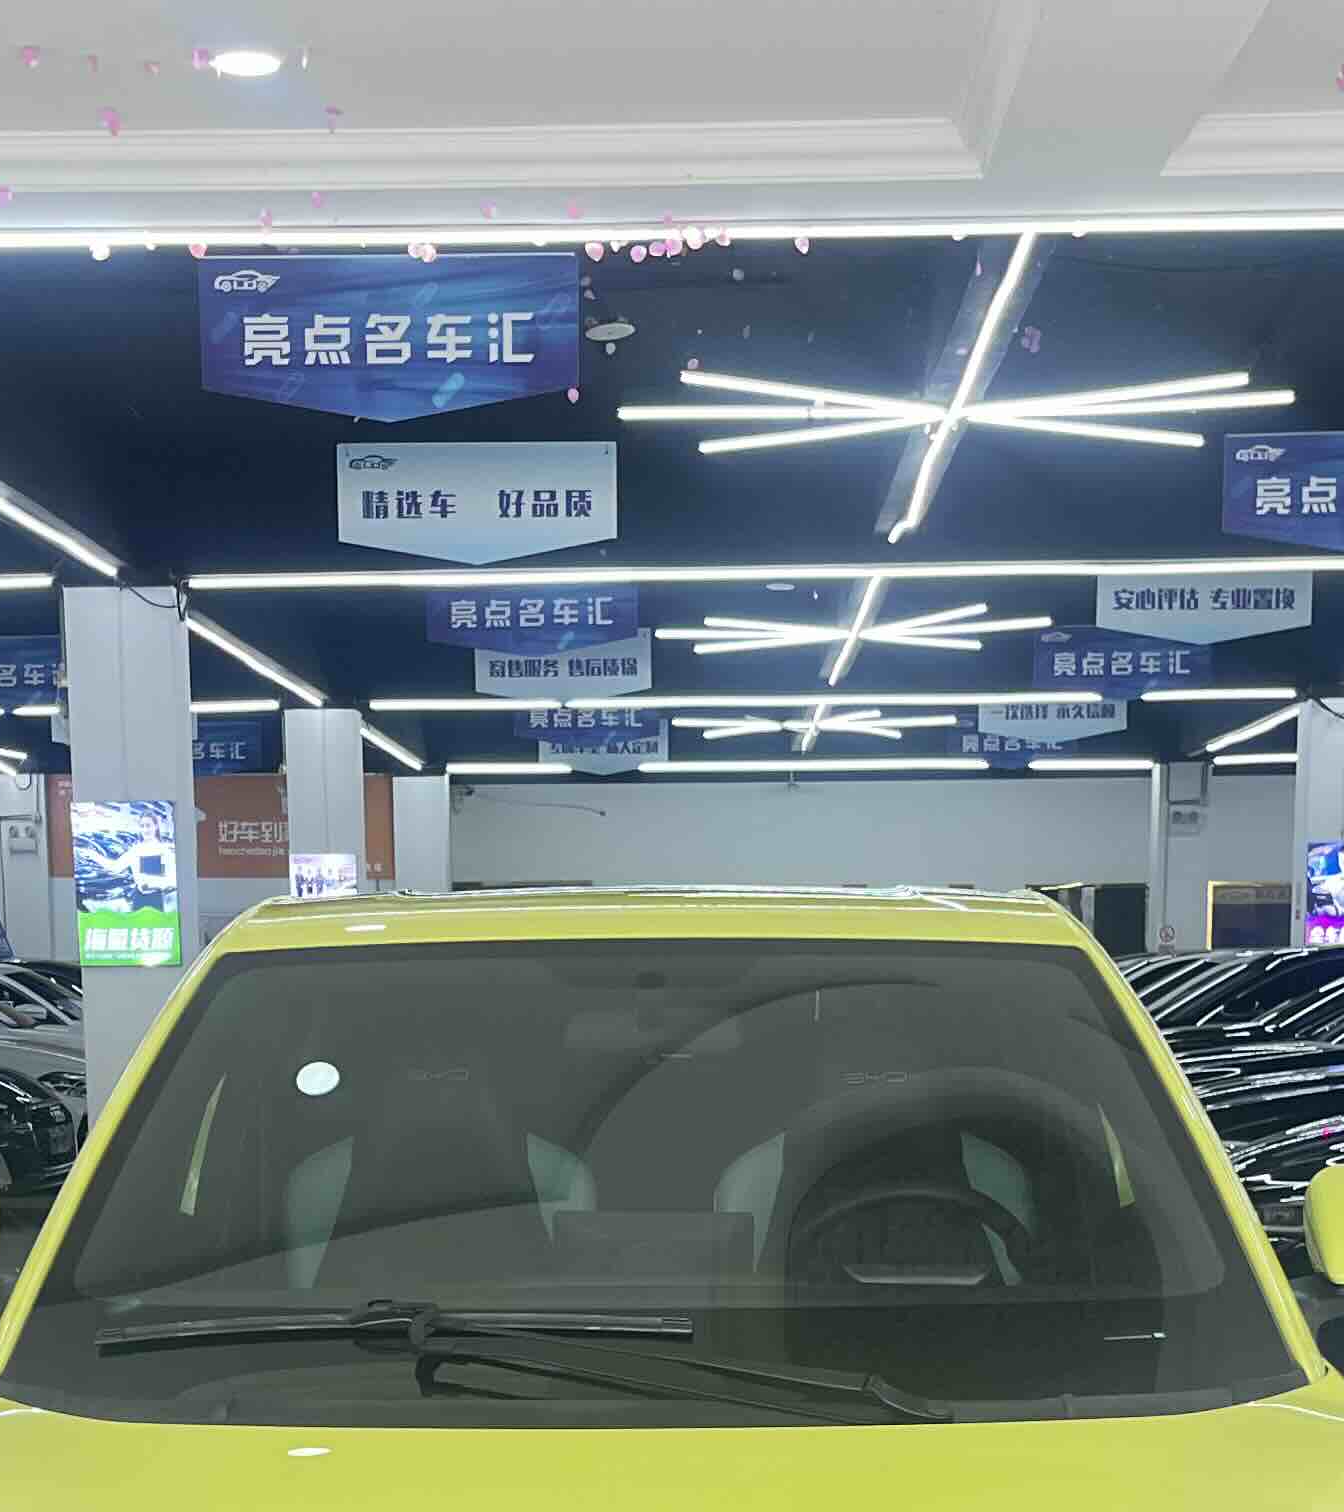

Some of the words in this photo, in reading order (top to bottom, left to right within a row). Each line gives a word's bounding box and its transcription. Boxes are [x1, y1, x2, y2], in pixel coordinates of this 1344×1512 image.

[242, 312, 534, 366] 亮点名车汇
[362, 490, 455, 519] 精选车
[498, 489, 593, 518] 好品质
[1113, 587, 1199, 611] 安心评估
[1209, 587, 1295, 611] 专业置换
[451, 597, 614, 629] 亮点名车汇
[1053, 651, 1191, 676] 亮点名车汇
[530, 708, 643, 728] 亮点名车汇
